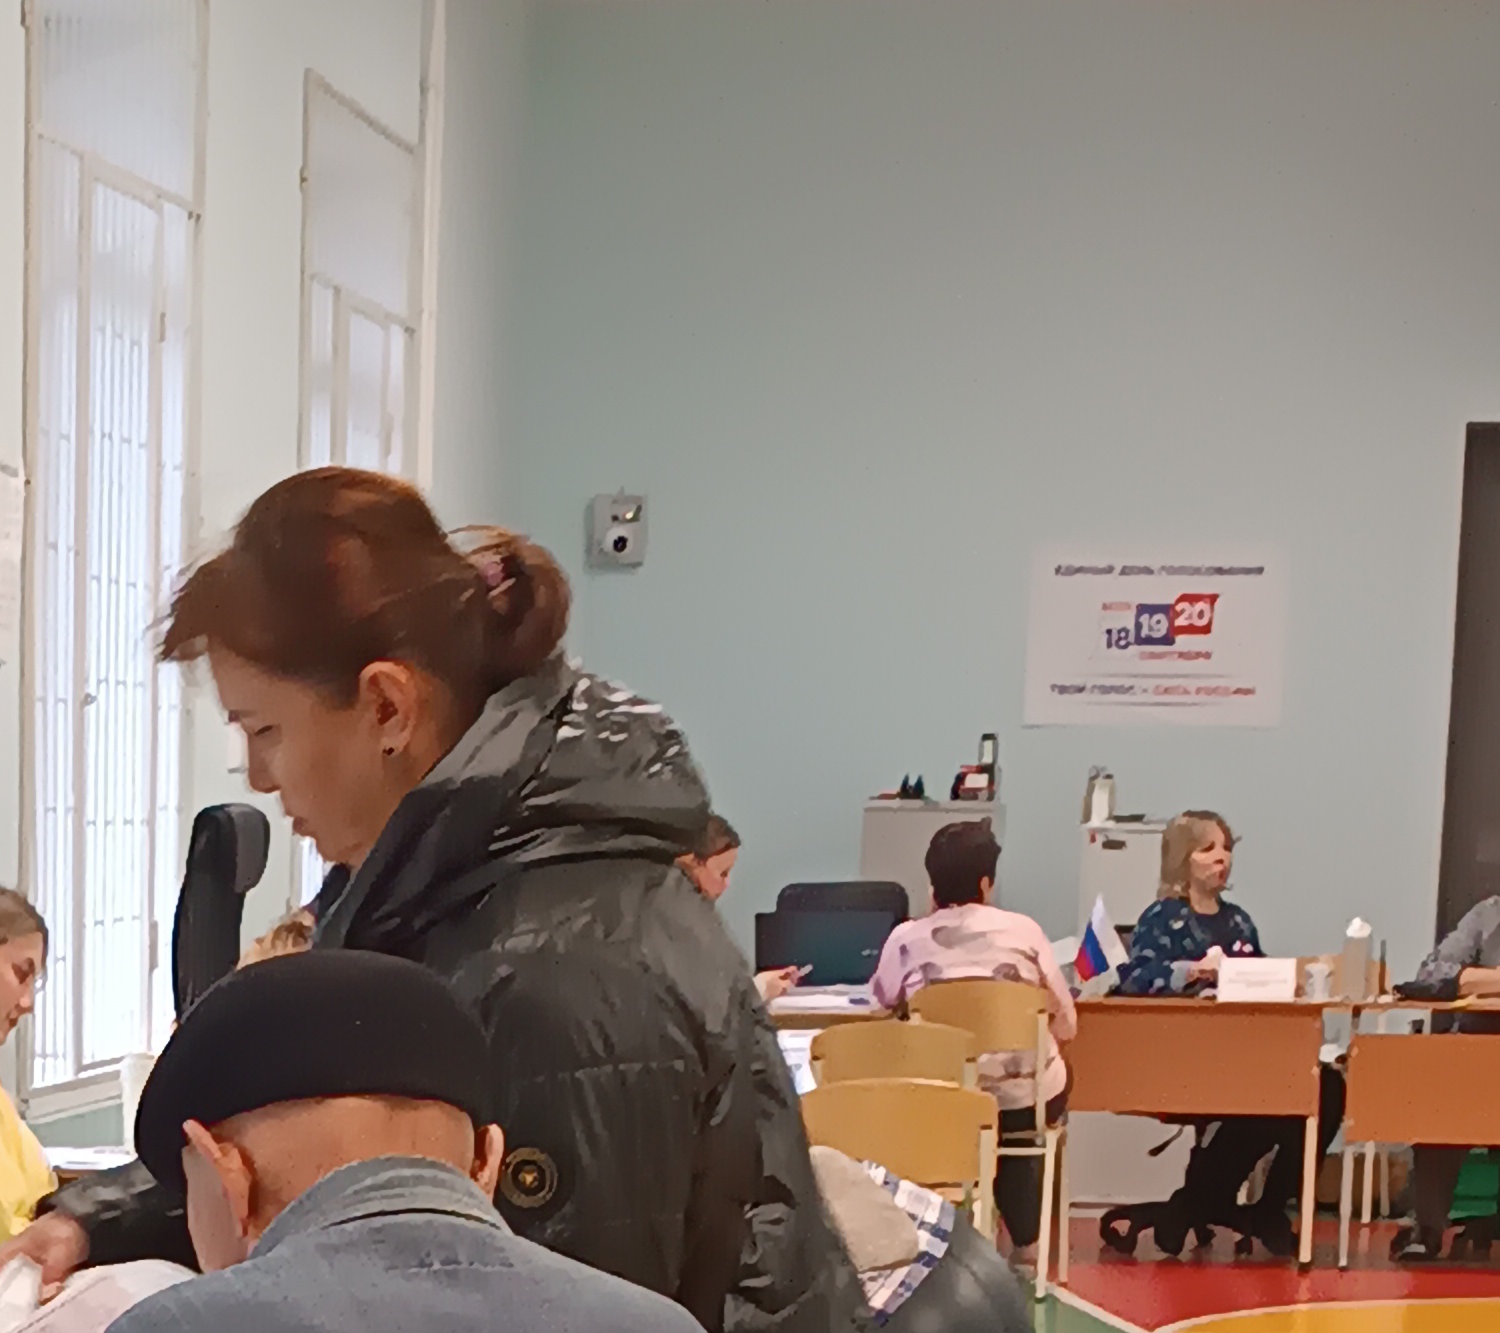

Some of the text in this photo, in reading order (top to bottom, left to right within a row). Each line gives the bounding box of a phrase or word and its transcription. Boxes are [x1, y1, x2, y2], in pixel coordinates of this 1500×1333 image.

[1105, 601, 1212, 650] 18 19 20
